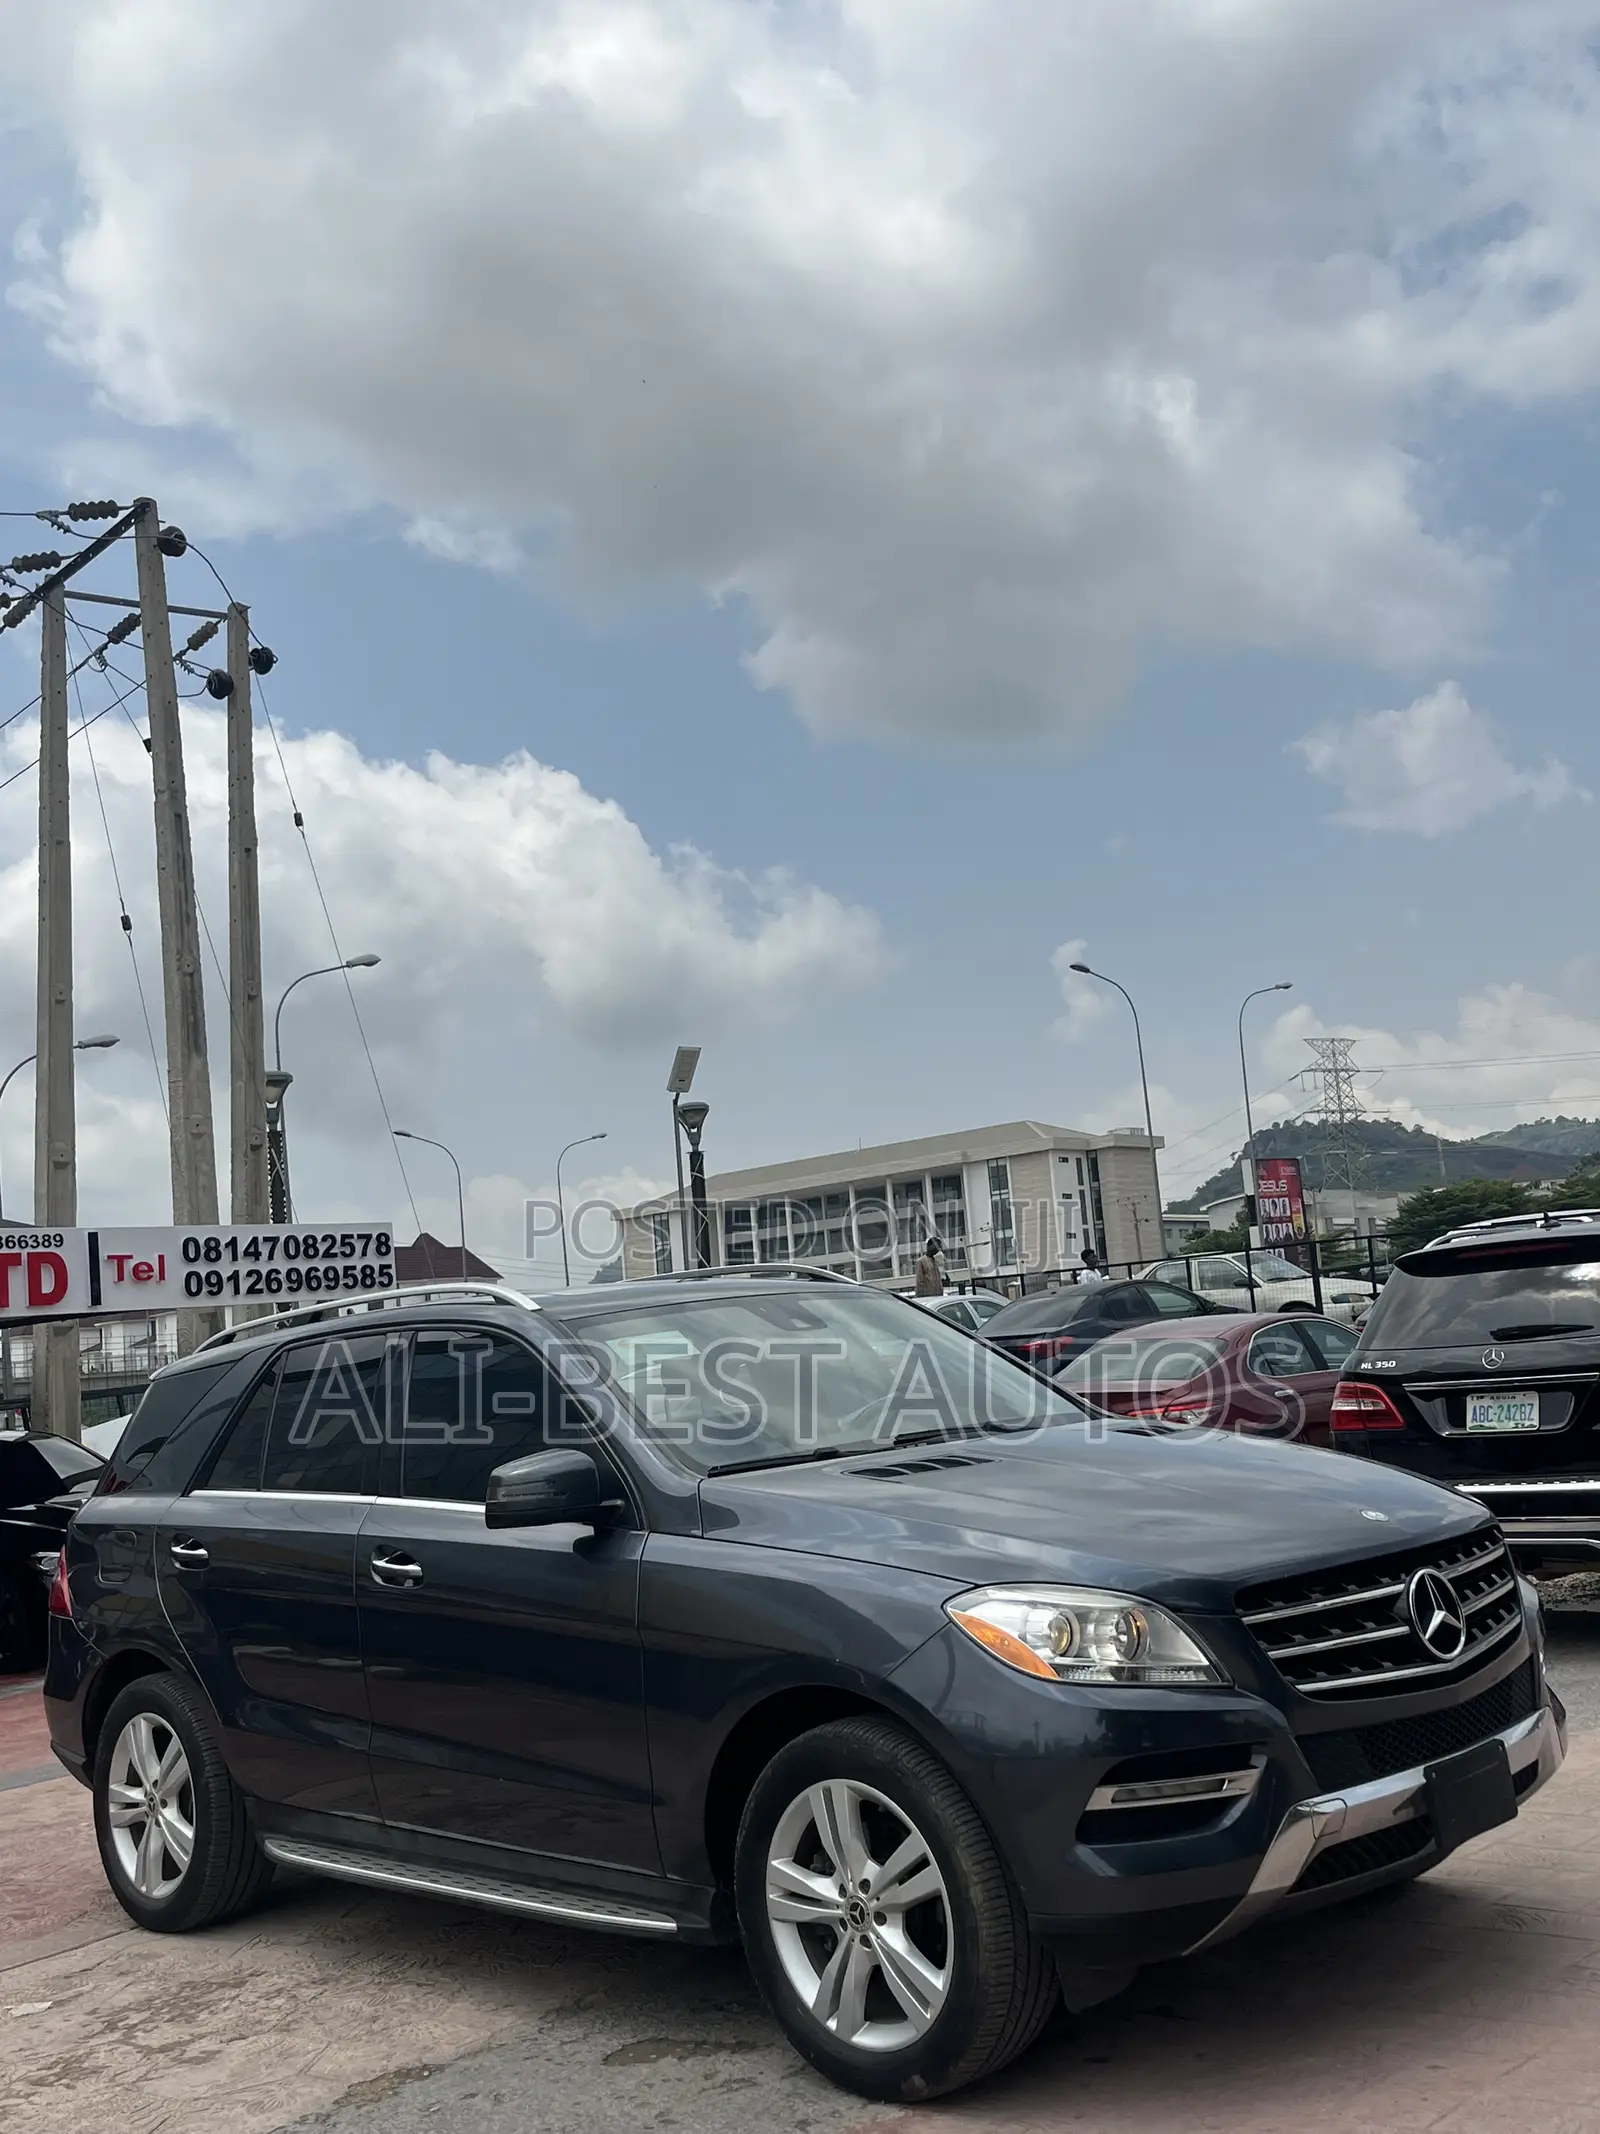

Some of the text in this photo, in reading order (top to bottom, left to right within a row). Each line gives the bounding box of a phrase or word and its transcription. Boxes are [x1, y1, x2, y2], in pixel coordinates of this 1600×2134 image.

[107, 1232, 391, 1283] Tel 08147082578
[184, 1264, 393, 1297] 09126969585
[1375, 1360, 1397, 1369] 350
[1471, 1403, 1535, 1423] ABC-242BZ
